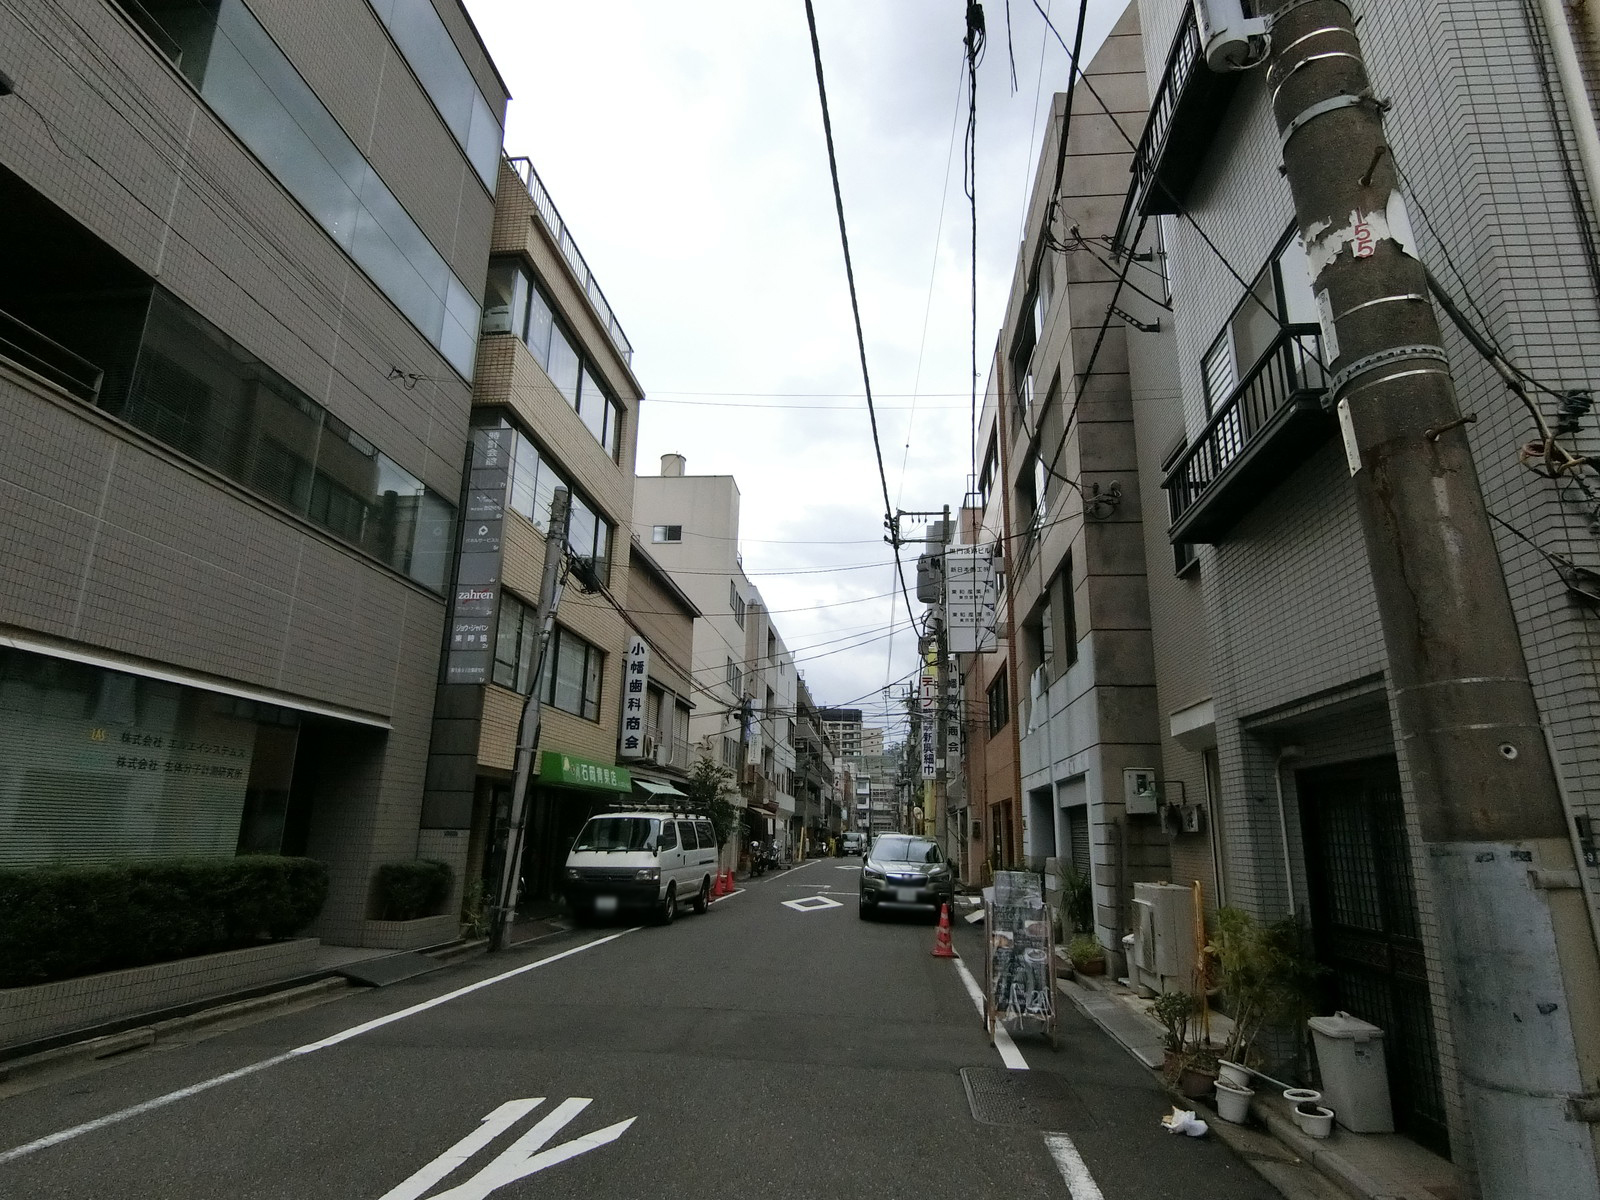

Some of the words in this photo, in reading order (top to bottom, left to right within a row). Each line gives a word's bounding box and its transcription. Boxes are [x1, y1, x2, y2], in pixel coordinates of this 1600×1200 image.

[1353, 206, 1375, 258] 155
[458, 589, 494, 599] zahren
[624, 641, 646, 750] 小幡歯科商会
[121, 731, 163, 750] 株式会社
[116, 755, 159, 771] 株式会社
